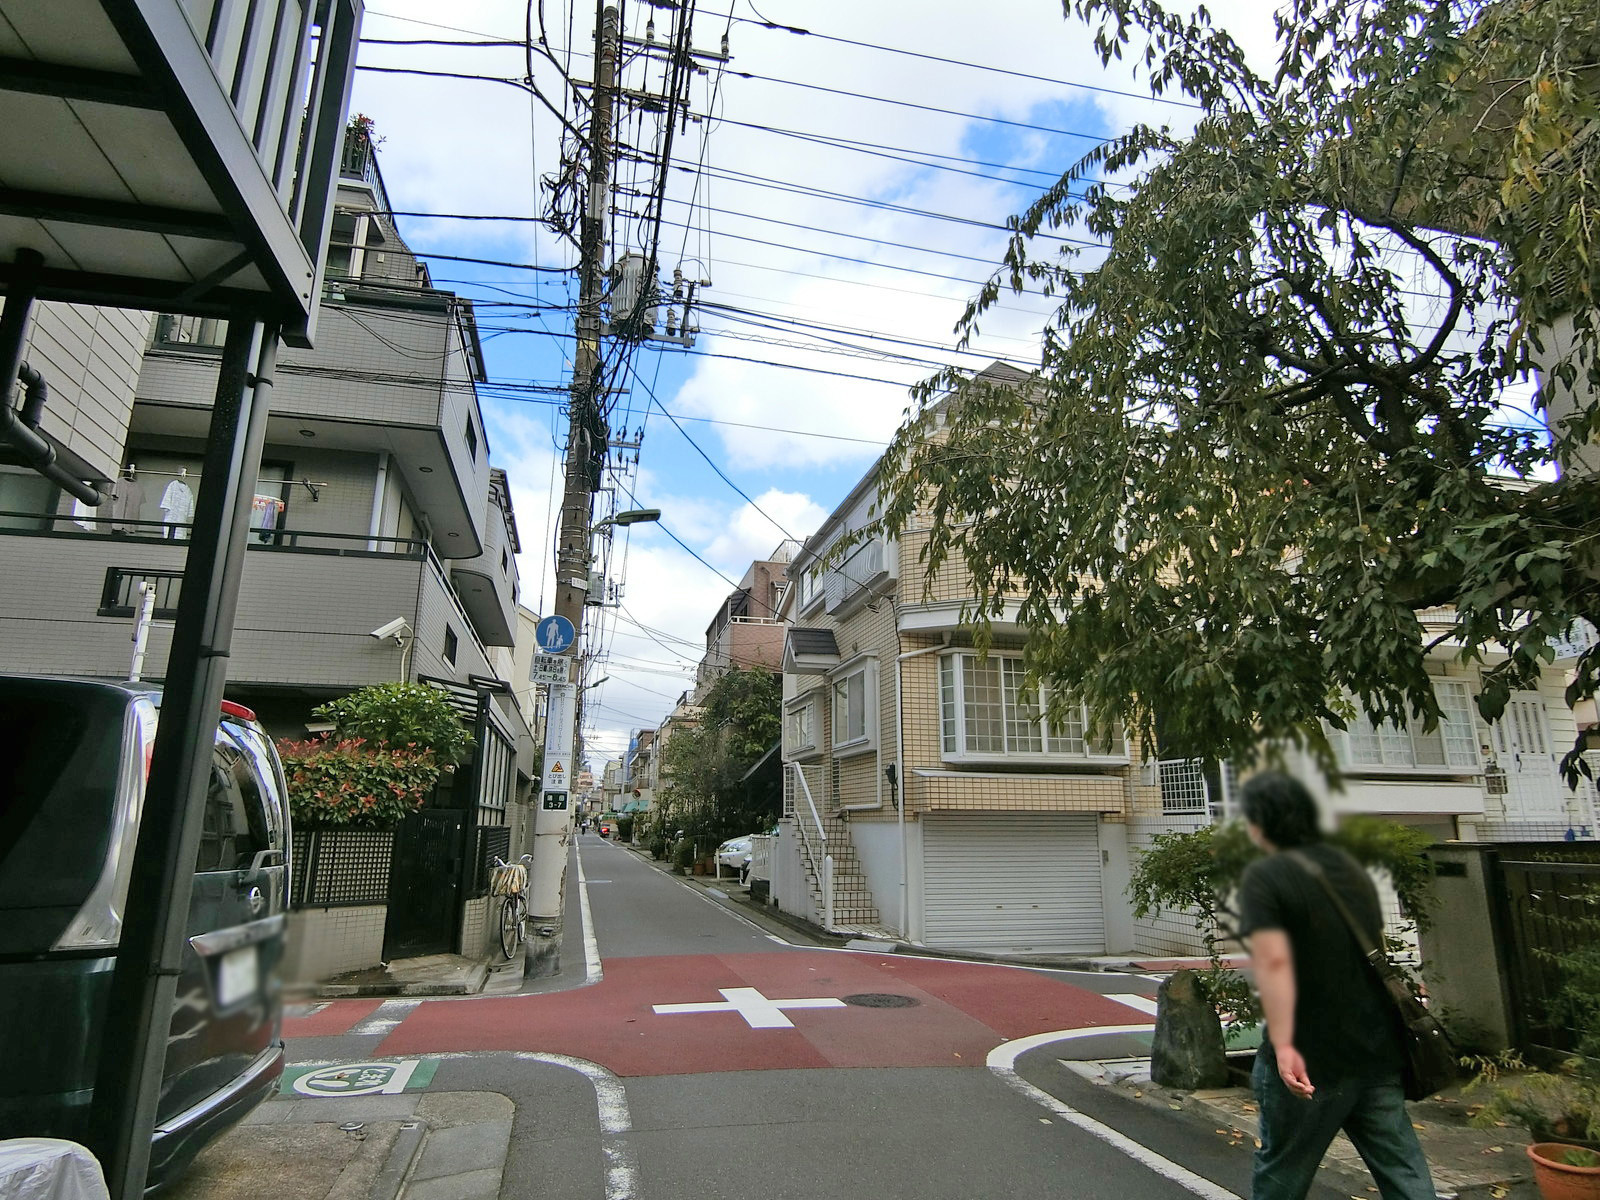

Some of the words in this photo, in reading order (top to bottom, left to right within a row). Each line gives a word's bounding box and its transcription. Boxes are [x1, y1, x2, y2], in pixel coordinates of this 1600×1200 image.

[535, 656, 568, 667] 自転車を除く
[354, 1068, 391, 1086] とまれ
